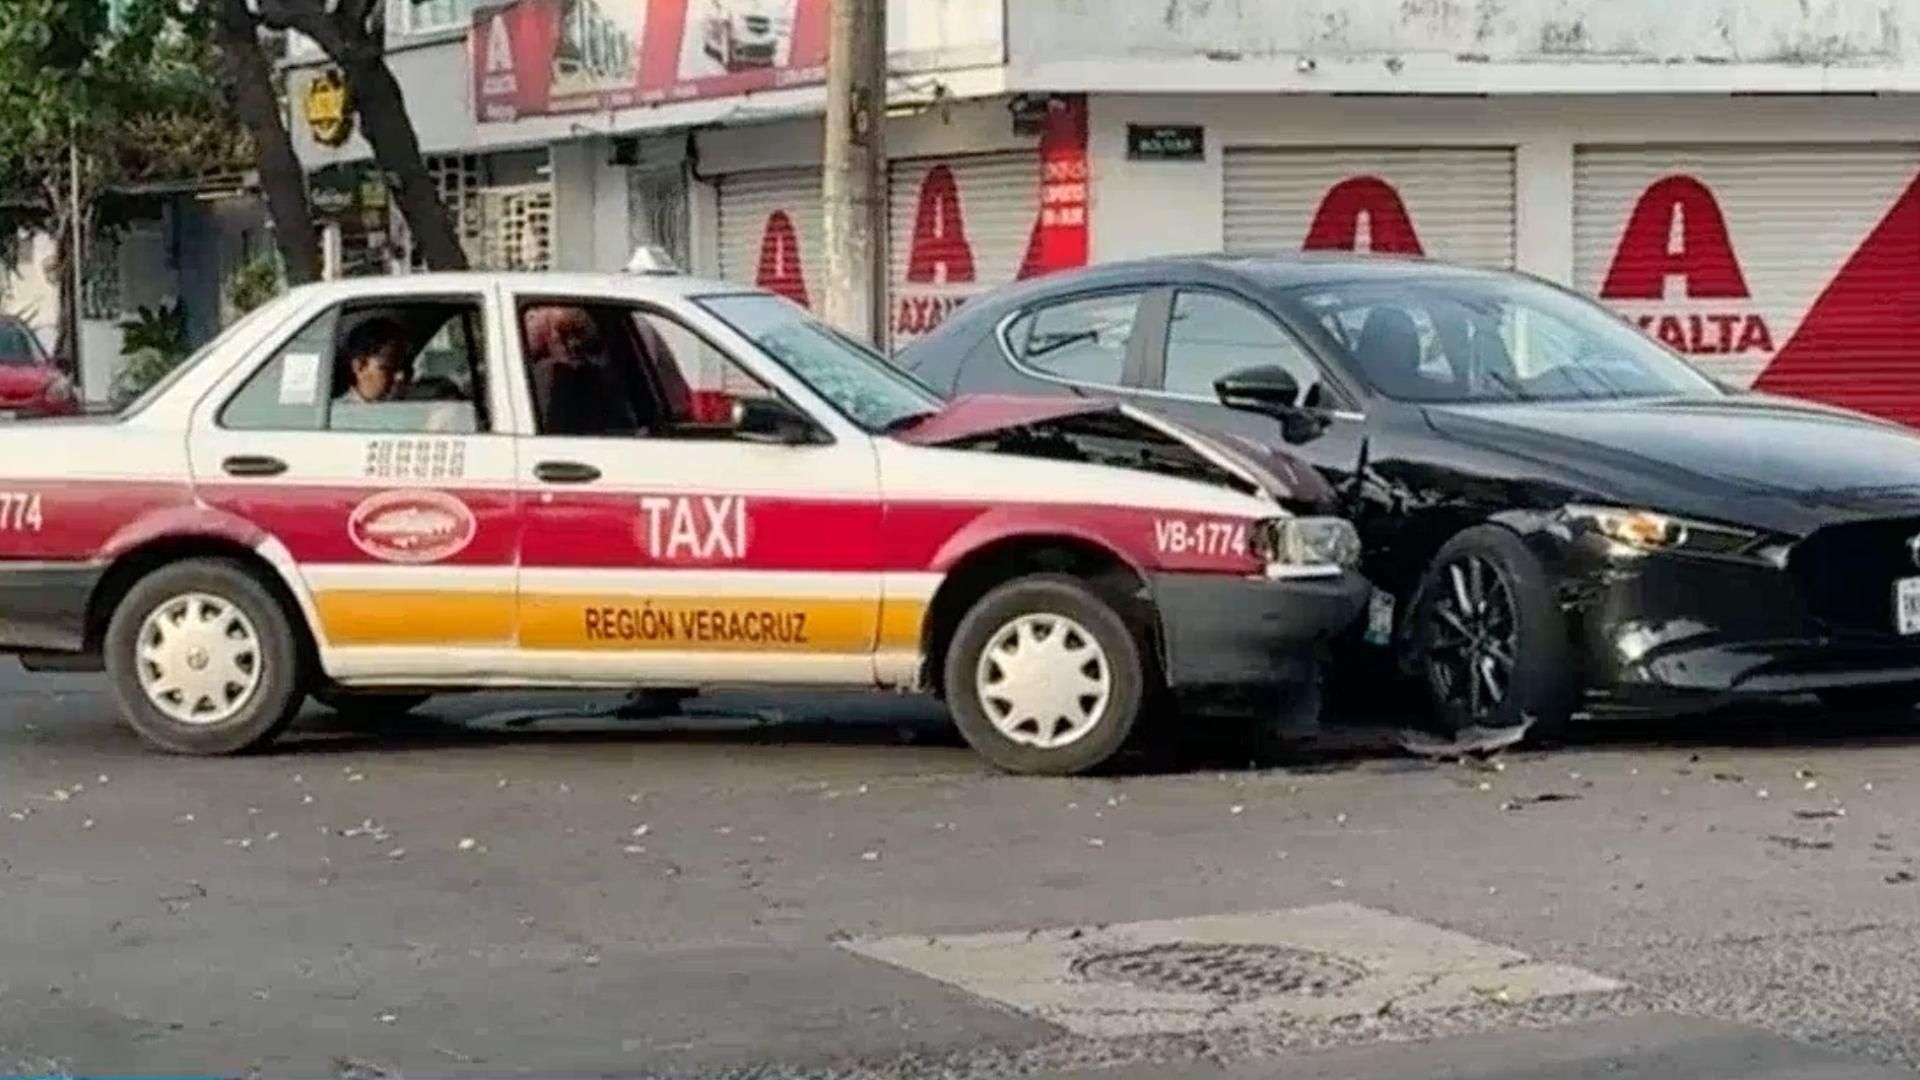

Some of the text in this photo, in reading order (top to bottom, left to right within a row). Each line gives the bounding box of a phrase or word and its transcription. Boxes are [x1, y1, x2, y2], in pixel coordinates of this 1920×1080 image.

[1600, 174, 1750, 298] A
[1622, 313, 1775, 354] ALTA
[641, 496, 745, 559] TAXI
[1154, 519, 1246, 557] VB-1774
[584, 601, 808, 643] REGIÓN VERACRUZ
